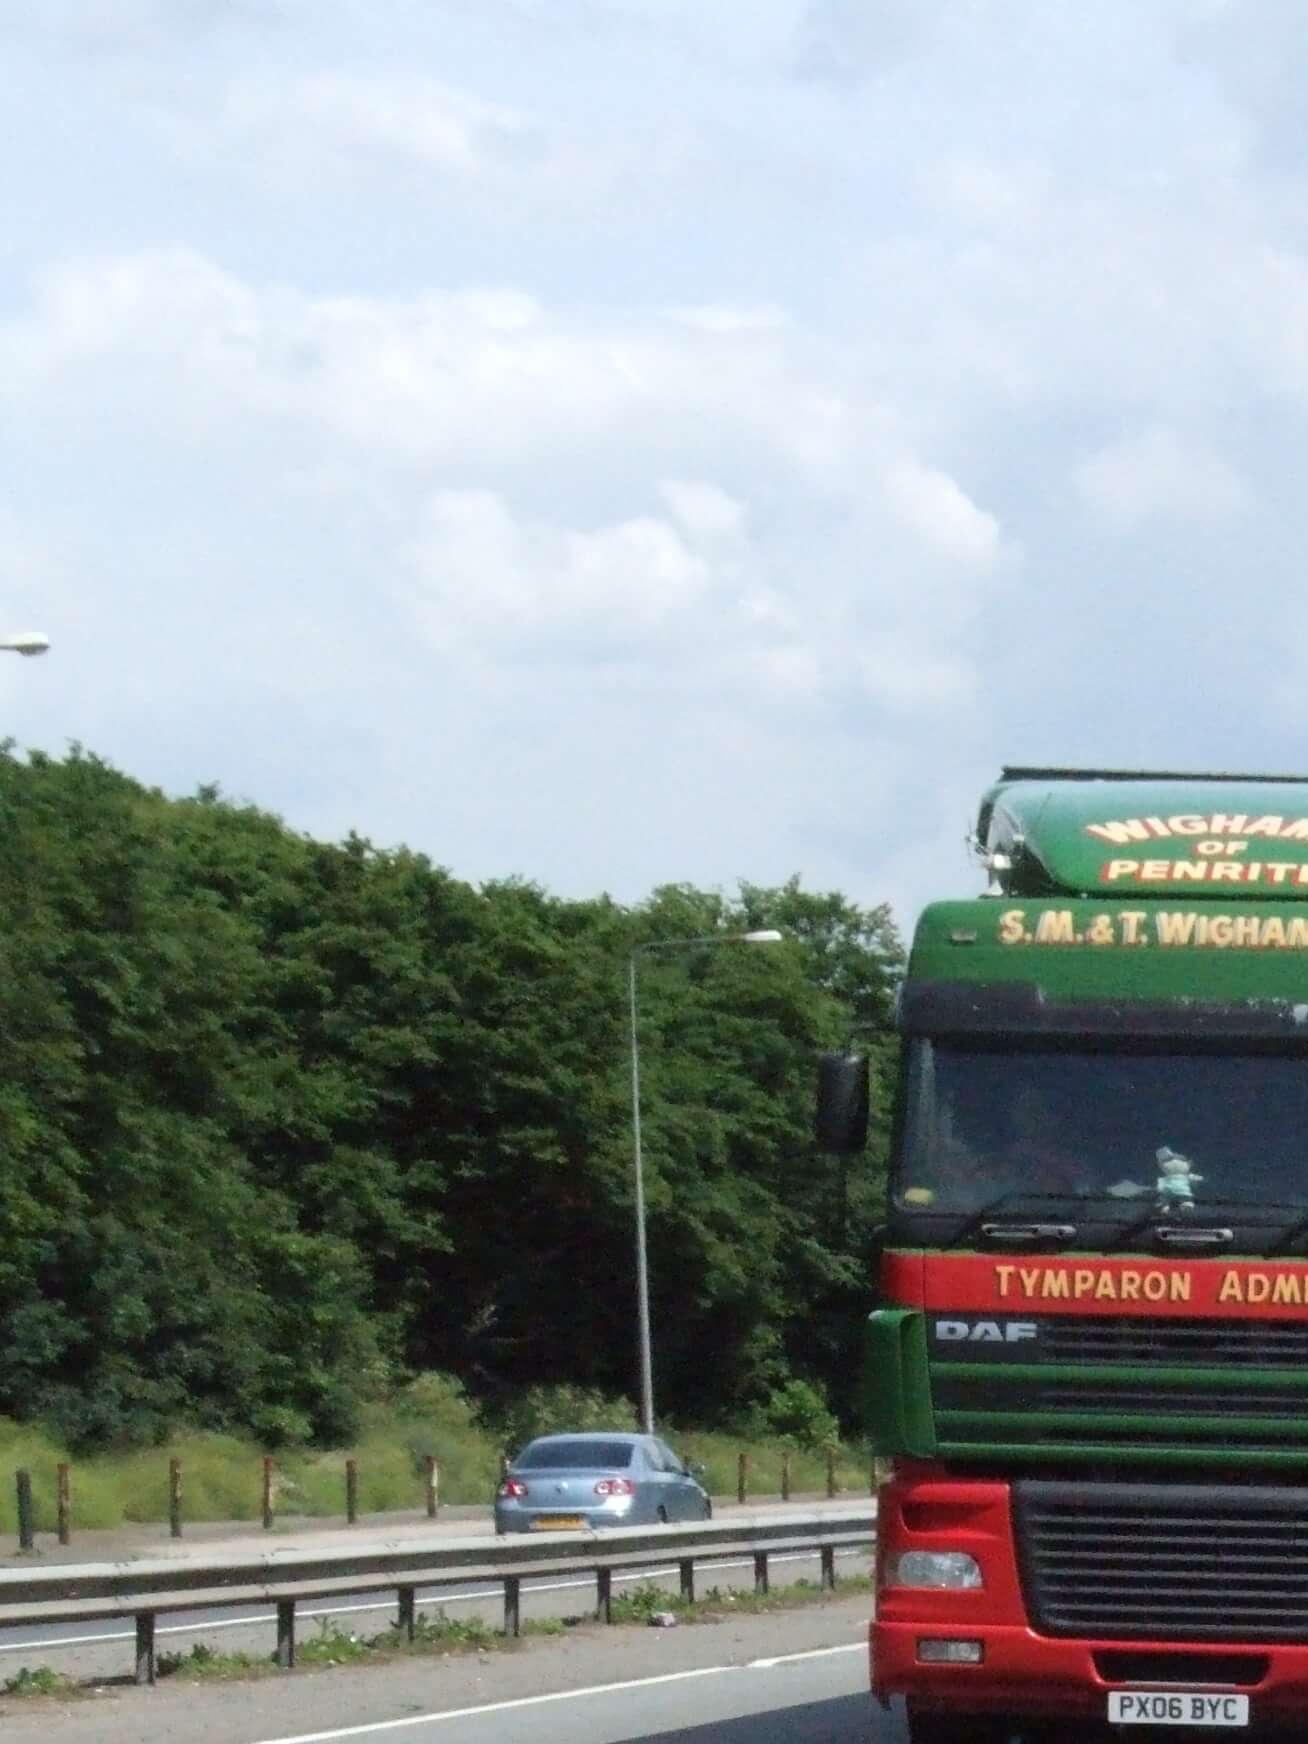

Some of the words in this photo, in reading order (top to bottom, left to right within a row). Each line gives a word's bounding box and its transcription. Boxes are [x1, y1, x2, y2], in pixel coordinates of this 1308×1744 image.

[1194, 840, 1249, 855] OF
[994, 1264, 1192, 1301] TYMPARON
[935, 1320, 1039, 1342] DAF
[1119, 1695, 1183, 1719] PX06
[1190, 1697, 1237, 1720] BYC
